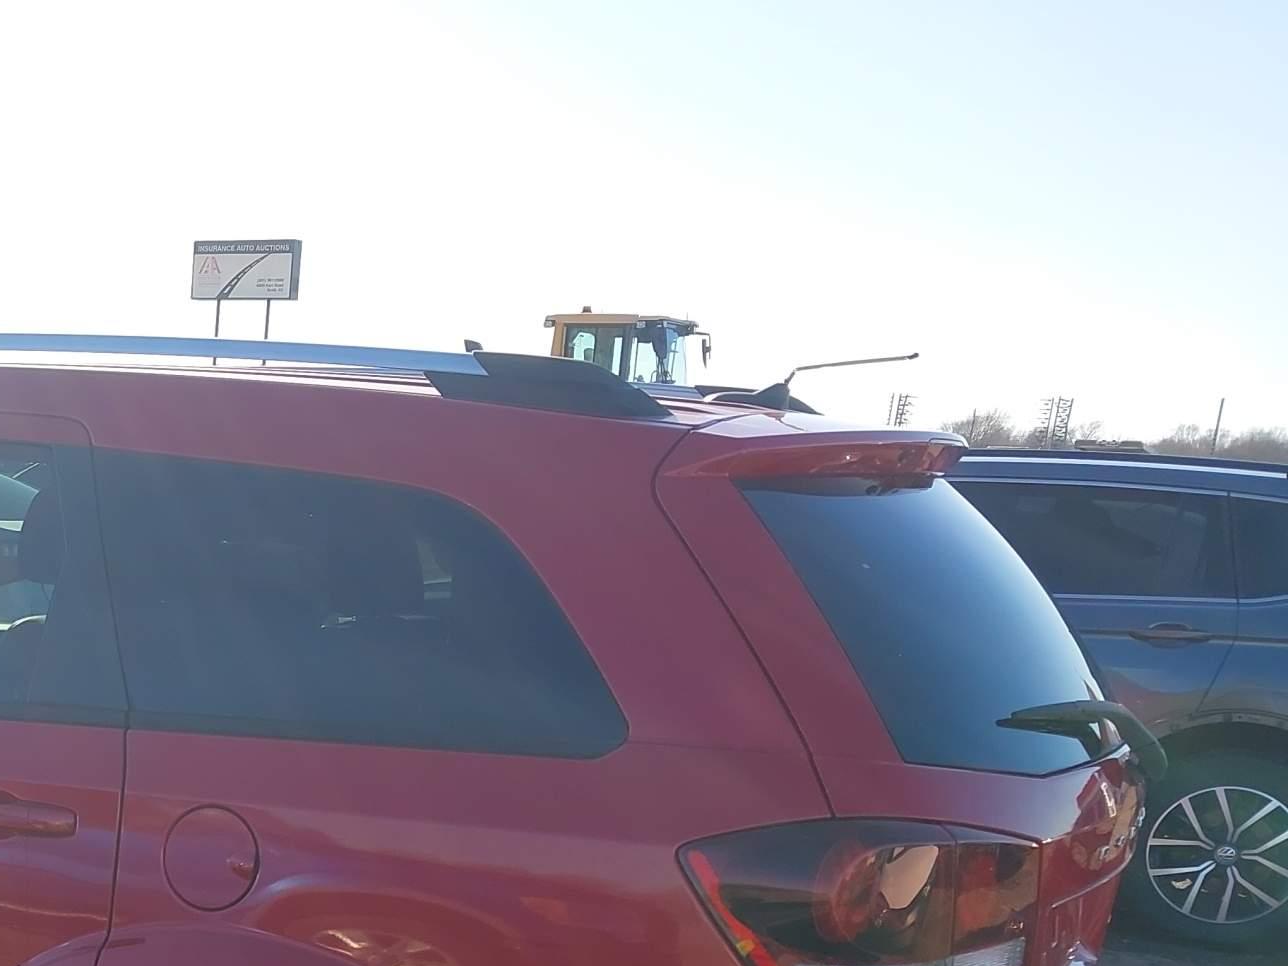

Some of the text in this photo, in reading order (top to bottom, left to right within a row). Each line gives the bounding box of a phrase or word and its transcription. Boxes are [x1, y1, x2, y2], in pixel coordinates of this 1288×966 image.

[198, 243, 290, 252] INSURANCE AUTO AUCTIONS
